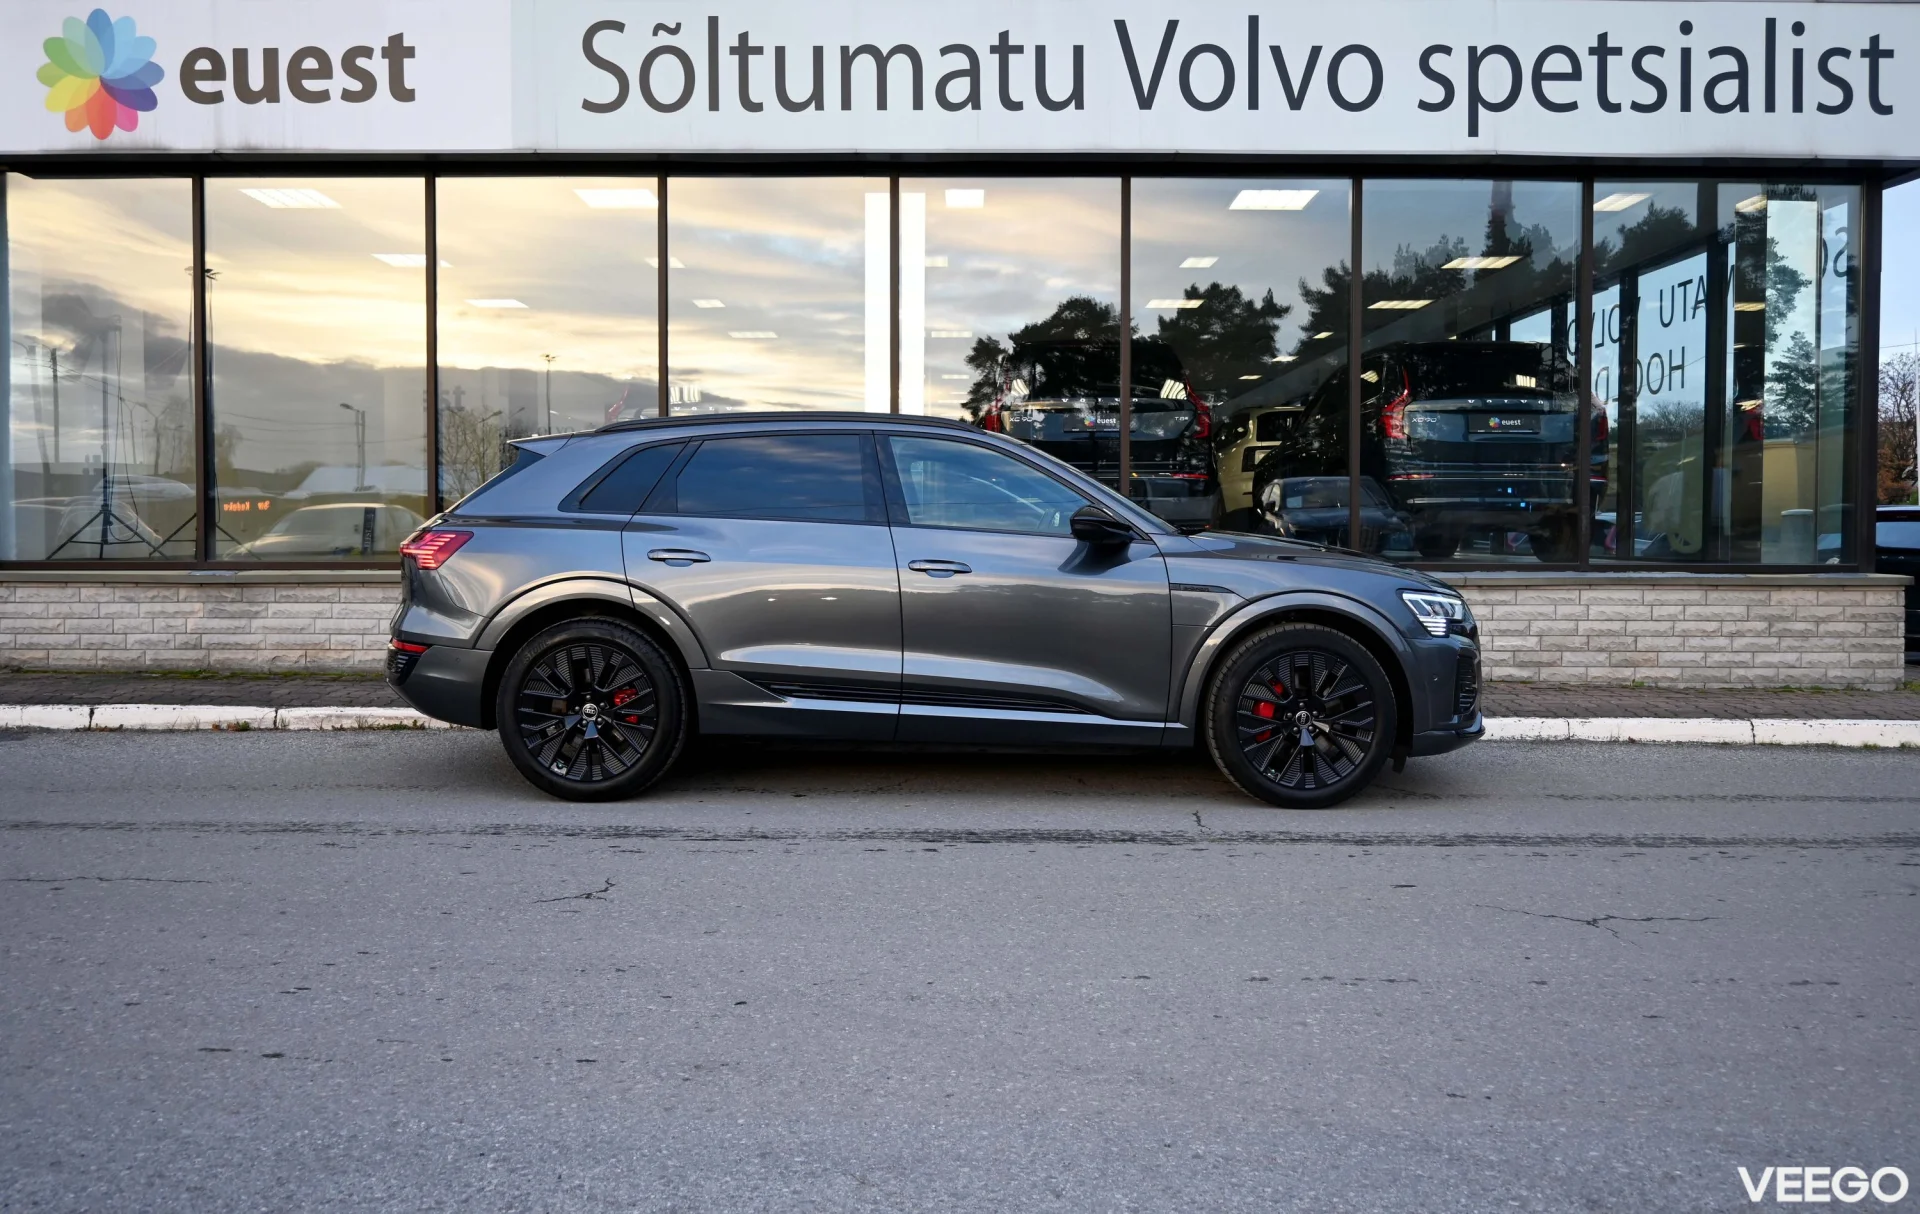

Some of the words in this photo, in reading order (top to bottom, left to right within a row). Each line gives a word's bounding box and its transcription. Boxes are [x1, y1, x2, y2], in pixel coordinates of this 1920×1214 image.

[179, 32, 416, 105] euest
[581, 15, 1085, 113] Sõltumatu
[1113, 15, 1384, 112] Volvo
[1417, 17, 1895, 138] spetsialist
[1501, 418, 1522, 426] euest
